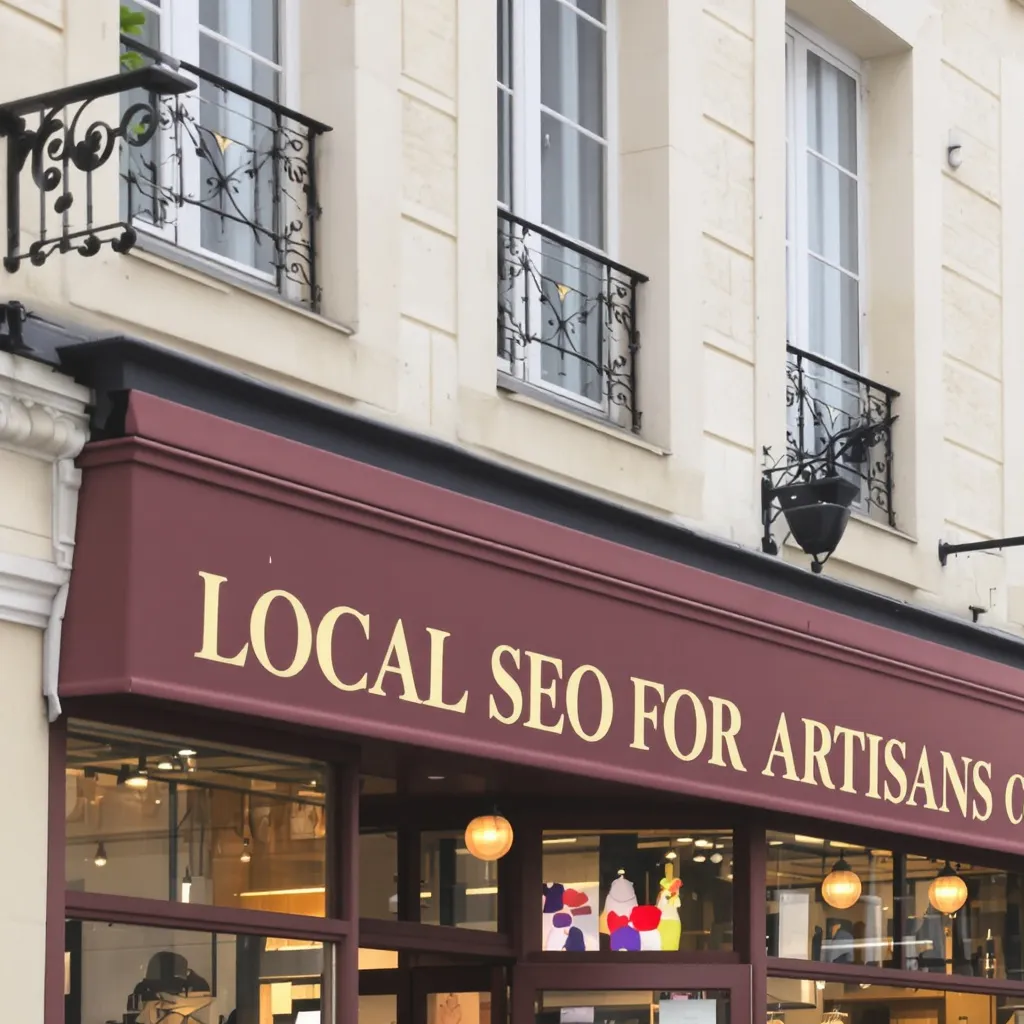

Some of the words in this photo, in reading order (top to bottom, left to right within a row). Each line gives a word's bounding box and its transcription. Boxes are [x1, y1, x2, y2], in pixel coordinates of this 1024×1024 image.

[195, 570, 469, 714] LOCAL
[488, 644, 614, 742] SEO
[630, 676, 748, 773] FOR
[761, 711, 993, 822] ARTISANS
